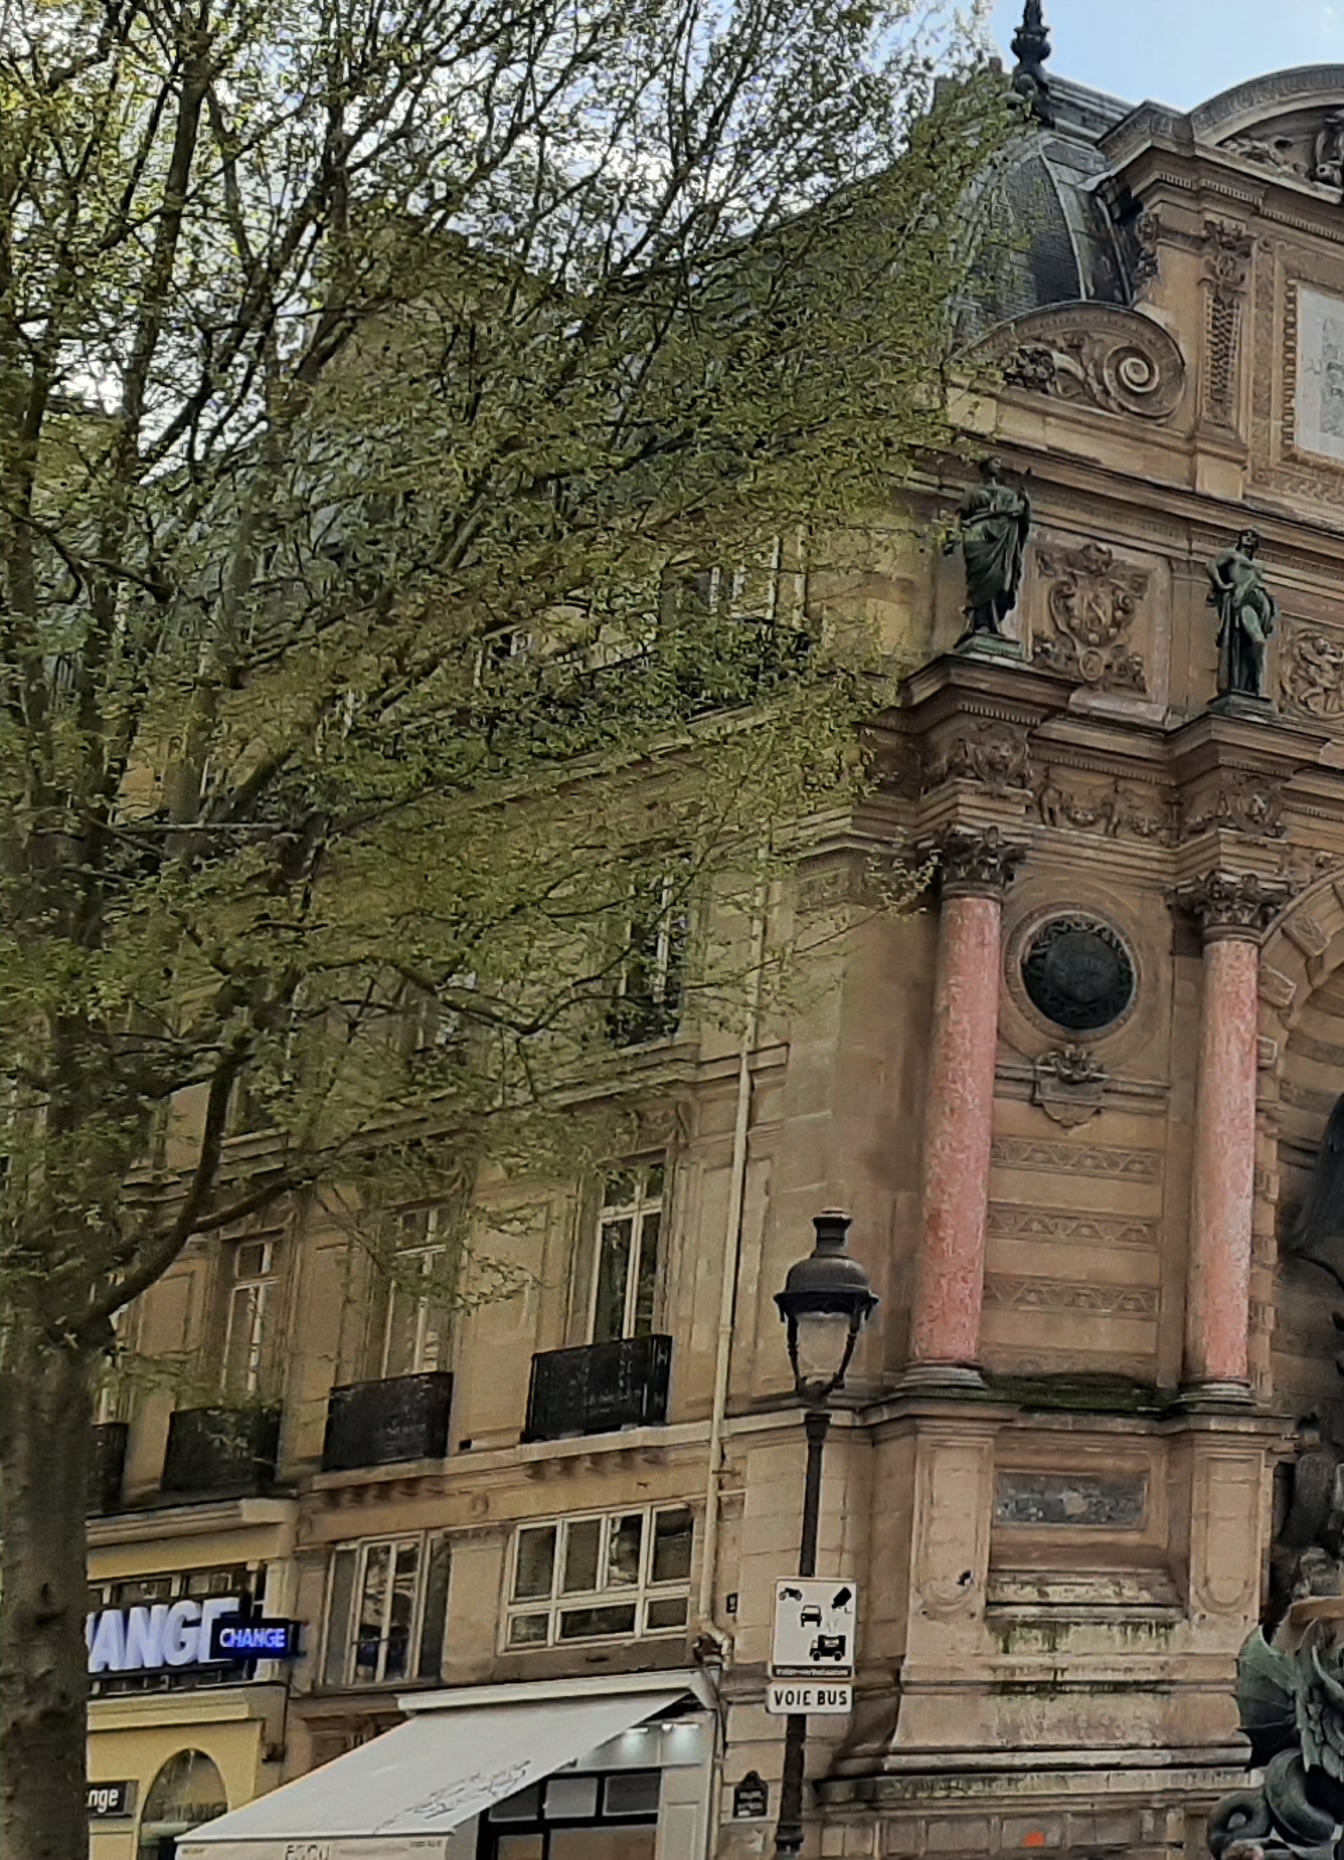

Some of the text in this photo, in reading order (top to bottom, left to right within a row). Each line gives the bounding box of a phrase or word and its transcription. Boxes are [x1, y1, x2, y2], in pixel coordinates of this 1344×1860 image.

[85, 1597, 240, 1673] ANGE
[219, 1628, 286, 1648] CHANGE
[774, 1690, 848, 1706] VOIE BUS
[86, 1788, 120, 1813] nge
